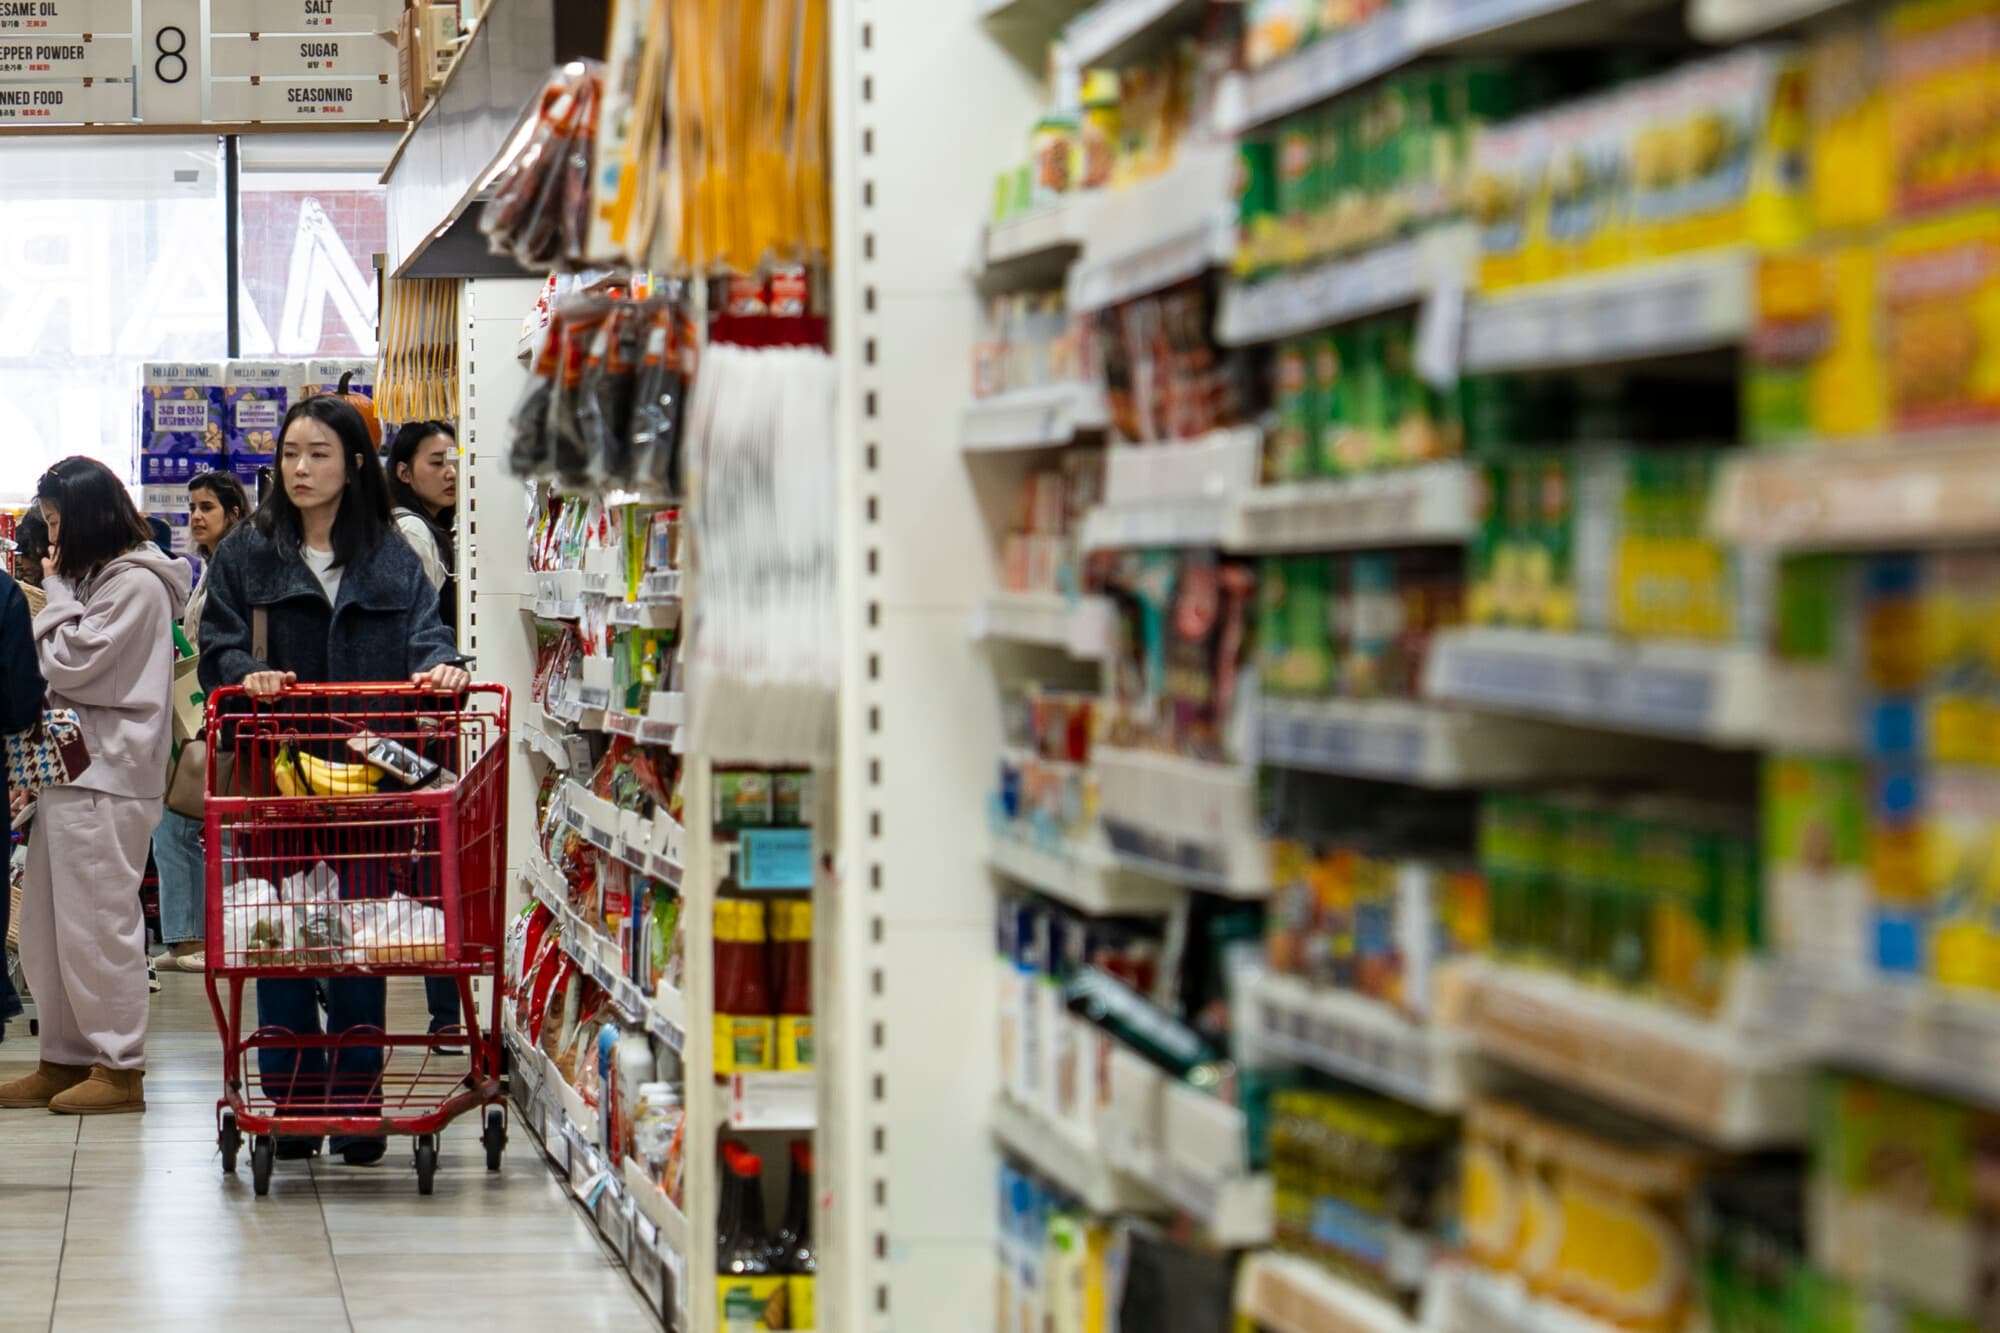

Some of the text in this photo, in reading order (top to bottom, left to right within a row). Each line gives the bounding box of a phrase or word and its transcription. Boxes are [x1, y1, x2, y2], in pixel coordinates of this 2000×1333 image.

[40, 2, 58, 16] OIL
[305, 0, 333, 14] SALT
[36, 46, 84, 60] POWDER
[155, 26, 187, 83] 8
[300, 43, 338, 57] SUGAR
[34, 91, 63, 105] FOOD
[288, 88, 353, 102] SEASONING
